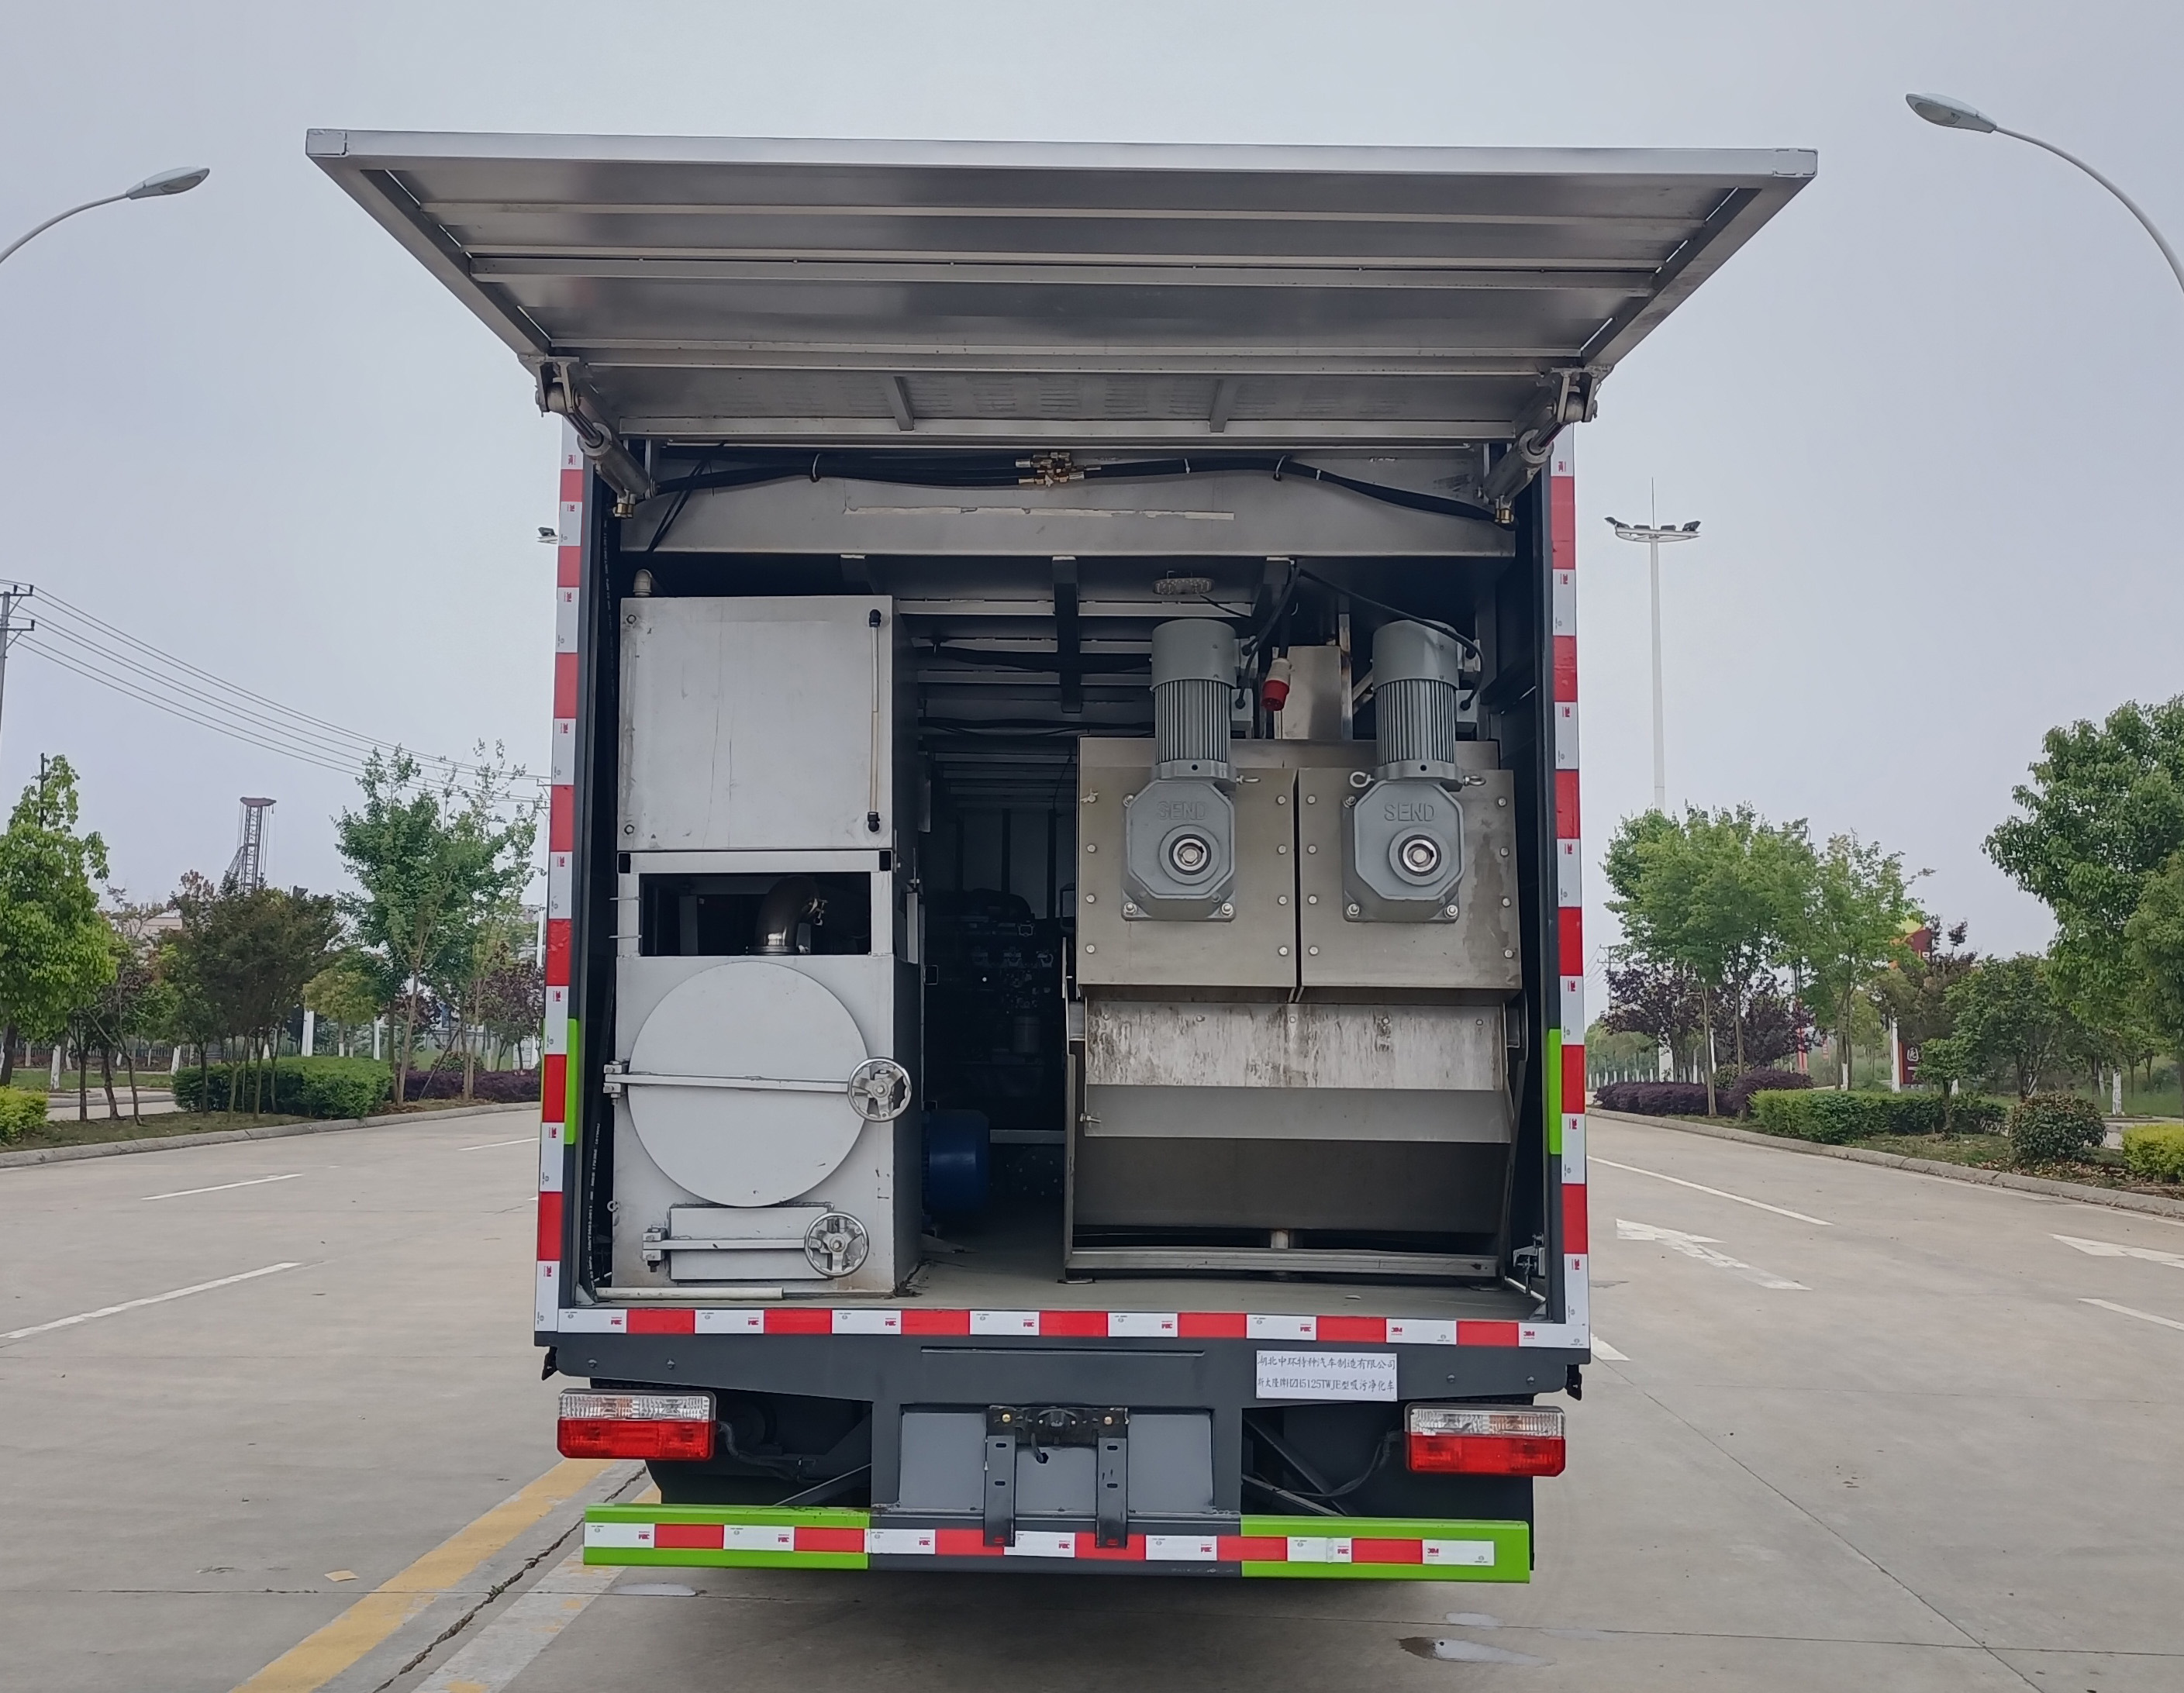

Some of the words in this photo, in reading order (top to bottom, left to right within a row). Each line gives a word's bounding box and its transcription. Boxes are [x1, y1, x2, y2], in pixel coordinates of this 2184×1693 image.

[1156, 801, 1208, 821] SEND
[1383, 802, 1437, 822] SEND
[1258, 1355, 1396, 1370] 湖北中环特种汽车制造有限公司
